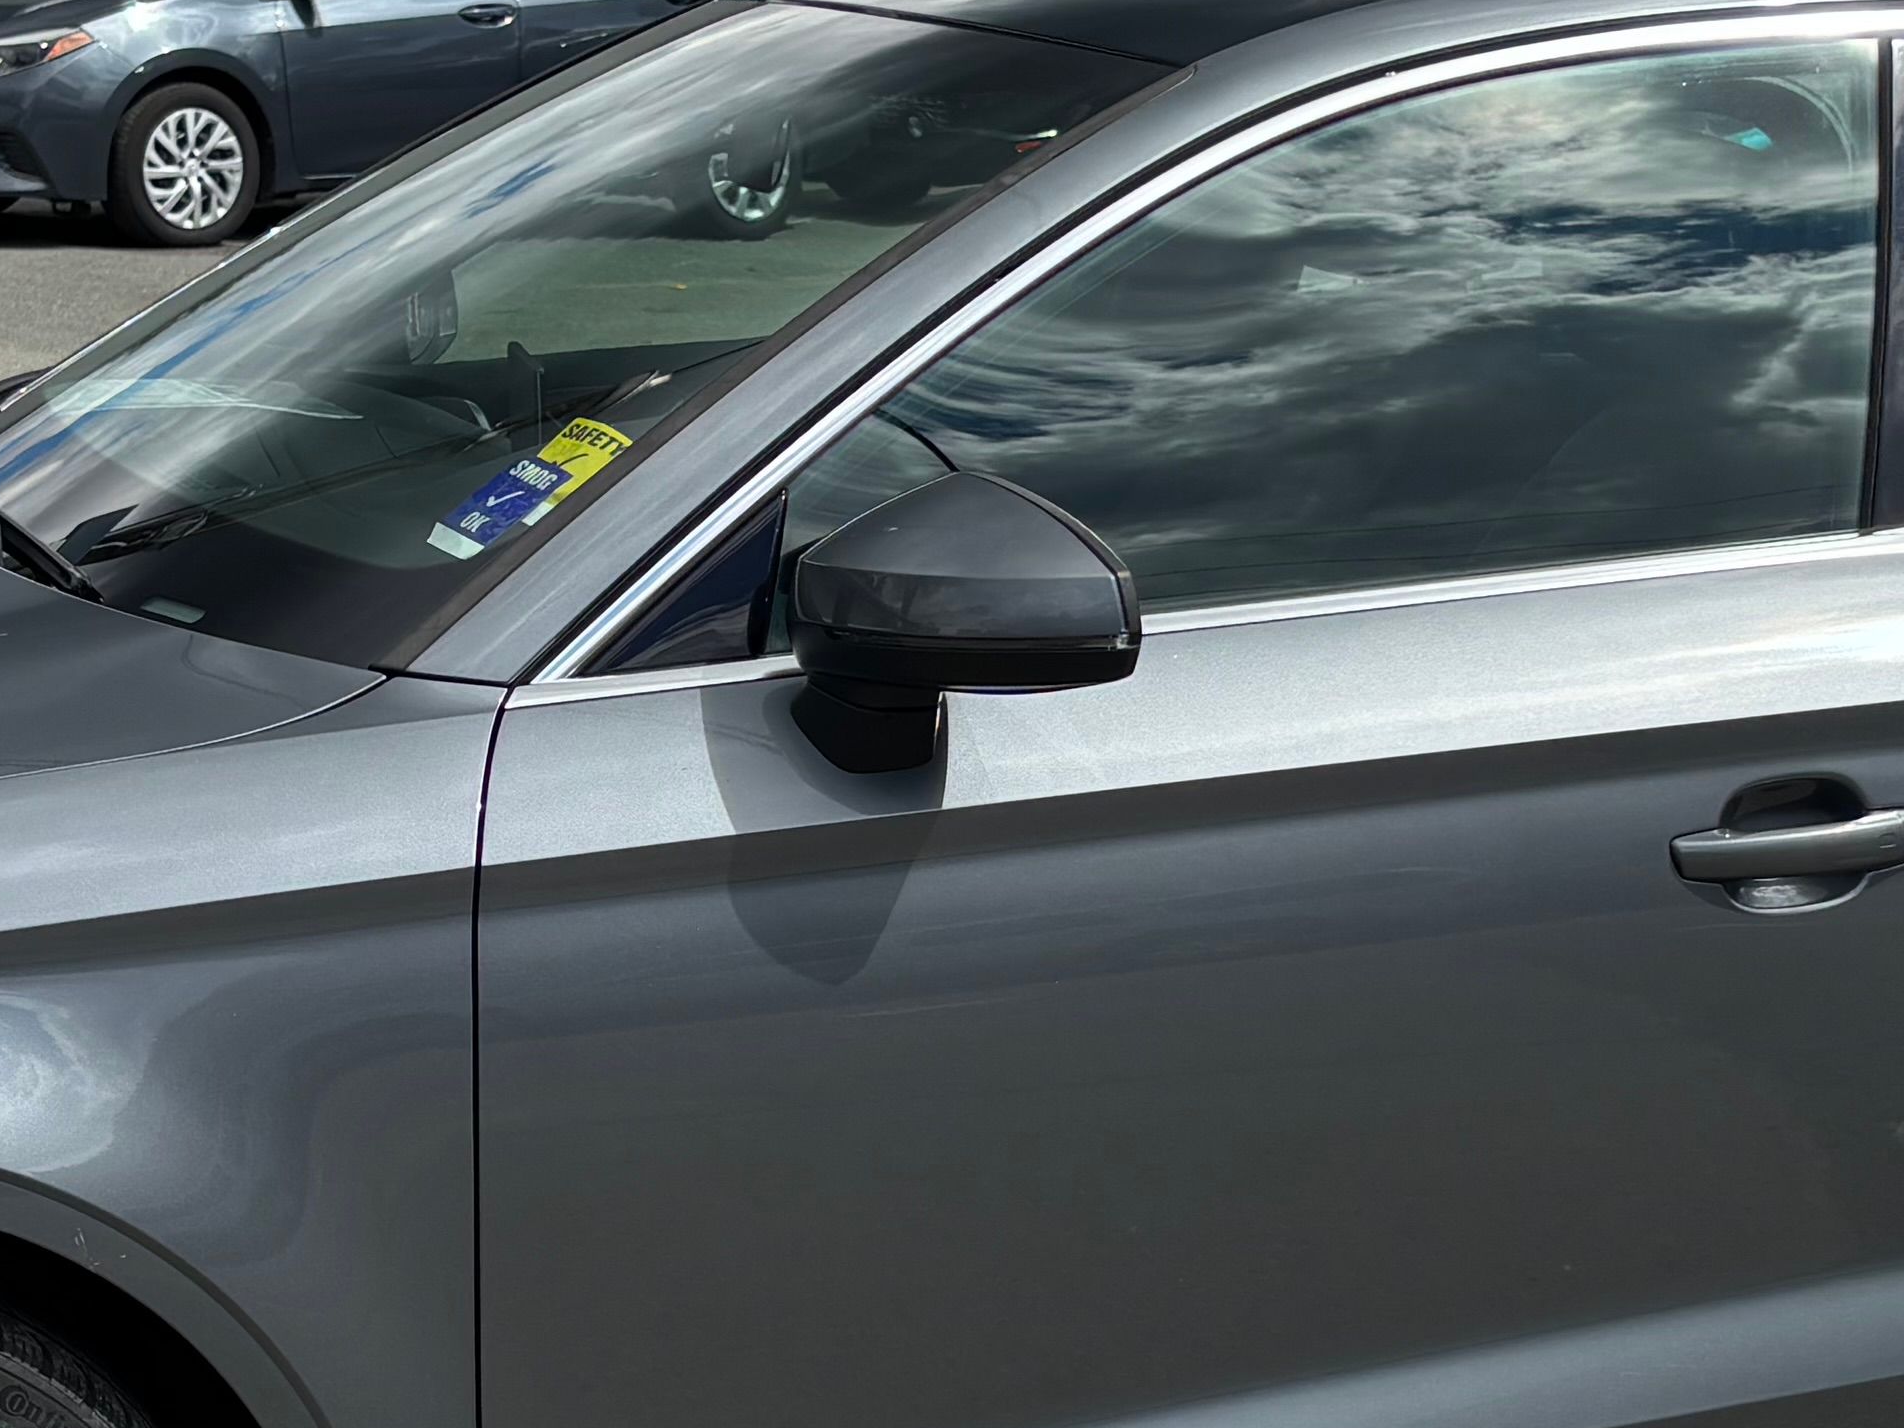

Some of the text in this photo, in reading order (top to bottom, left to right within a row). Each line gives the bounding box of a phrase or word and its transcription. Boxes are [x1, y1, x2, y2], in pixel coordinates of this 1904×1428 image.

[561, 423, 624, 456] SAFETY
[509, 460, 558, 490] SMOG
[460, 512, 490, 532] OK
